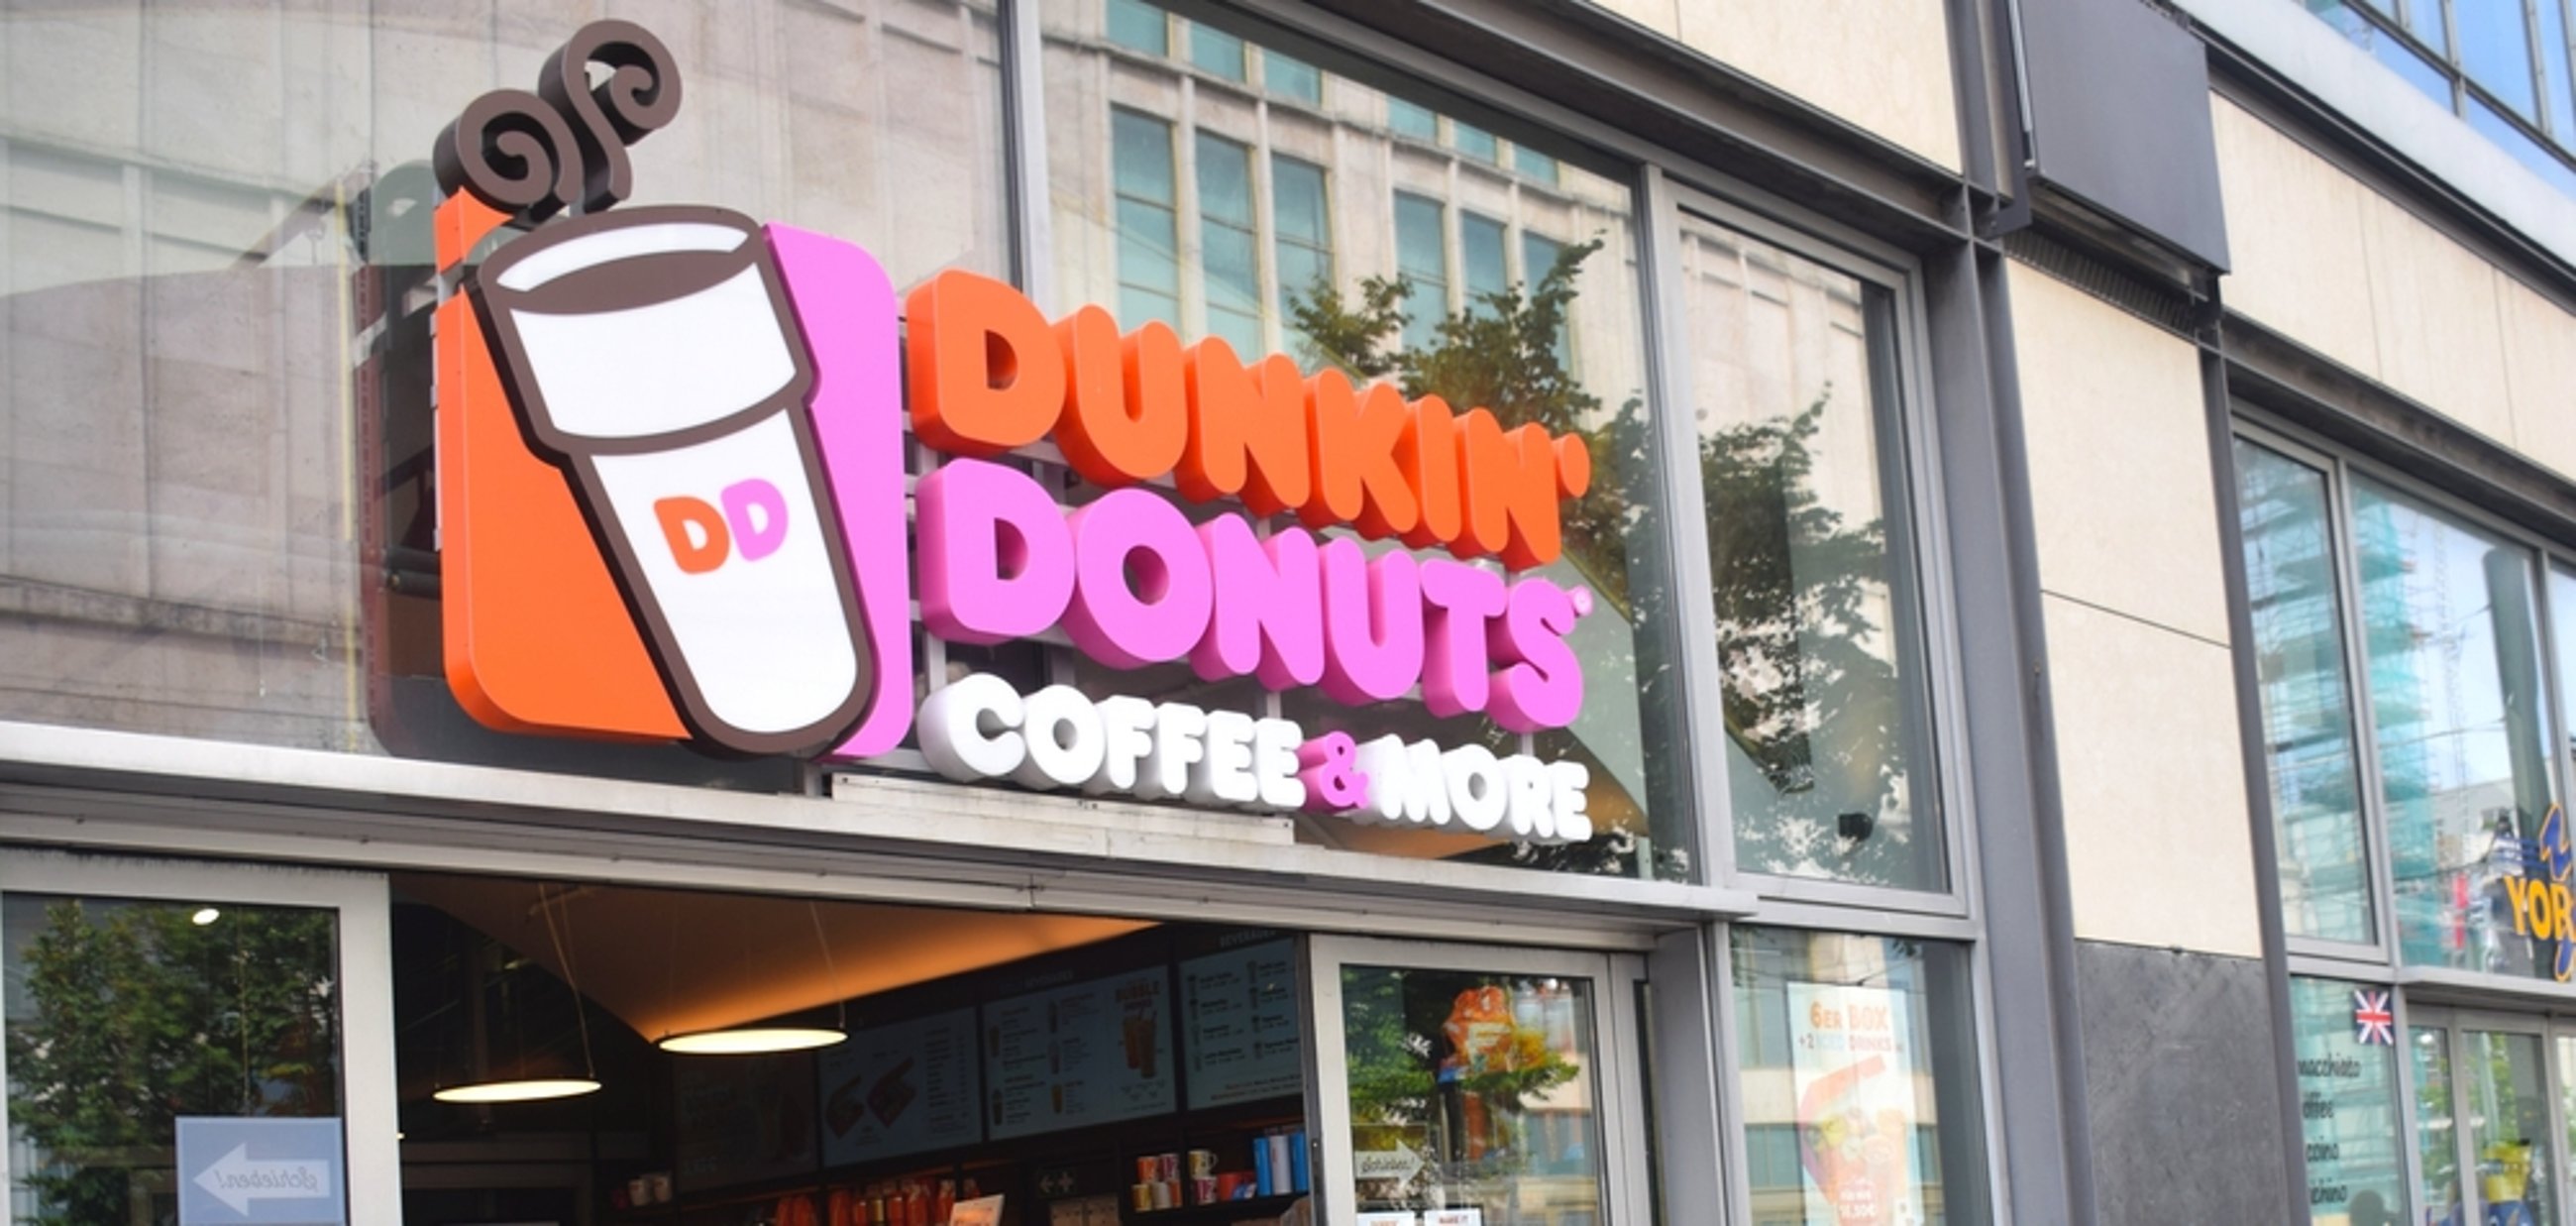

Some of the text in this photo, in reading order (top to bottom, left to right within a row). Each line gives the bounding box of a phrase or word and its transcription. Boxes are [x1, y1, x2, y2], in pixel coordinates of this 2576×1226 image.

[907, 270, 1590, 571] DUNKIN'
[654, 479, 789, 575] DD
[917, 674, 1592, 841] COFFEE & MORE
[2504, 875, 2576, 943] YOR
